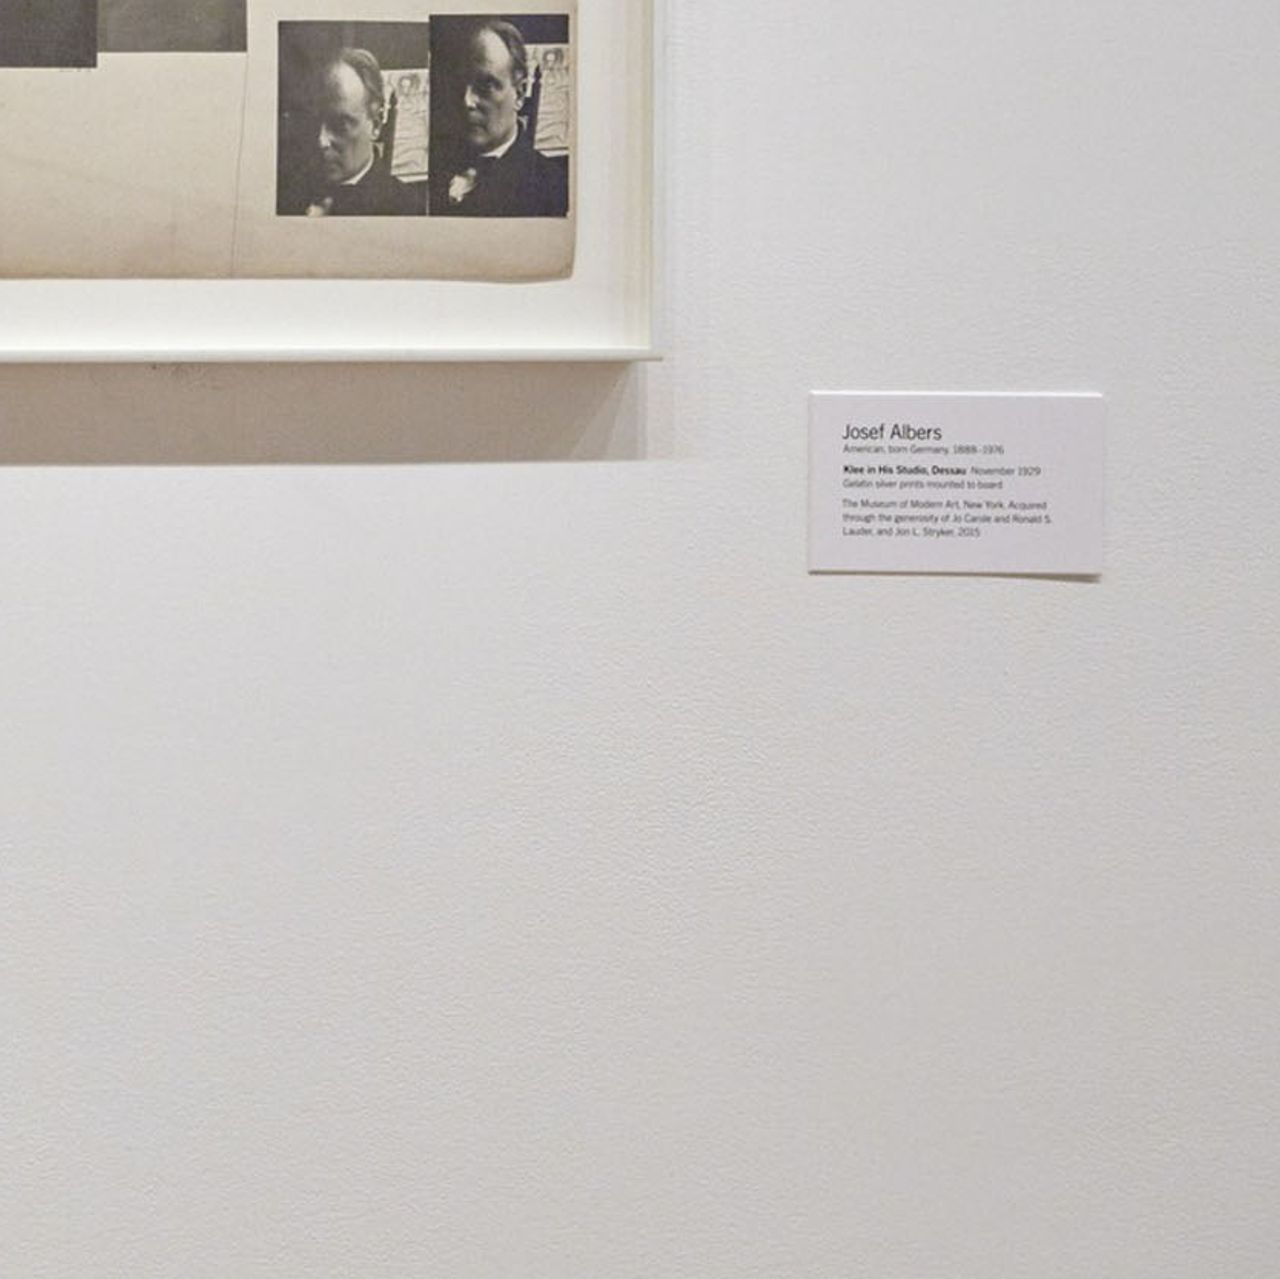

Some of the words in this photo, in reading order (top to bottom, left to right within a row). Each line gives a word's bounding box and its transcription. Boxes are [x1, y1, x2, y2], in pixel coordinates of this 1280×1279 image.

[842, 423, 884, 441] Josef
[889, 423, 943, 441] Albers
[888, 444, 907, 454] born
[843, 465, 865, 475] Klee
[867, 465, 876, 475] in
[878, 465, 894, 475] His
[896, 465, 929, 476] Studio,
[970, 465, 1015, 476] November
[842, 479, 873, 489] Gelatin
[875, 479, 897, 489] silver
[899, 479, 924, 490] prints
[926, 479, 965, 489] mounted
[967, 480, 976, 490] to
[977, 480, 1003, 490] board
[842, 499, 858, 508] The
[860, 499, 898, 509] Museum
[900, 499, 908, 509] of
[910, 499, 943, 509] Modern
[962, 500, 983, 510] New
[842, 513, 876, 524] through
[878, 513, 892, 523] the
[894, 513, 939, 524] generosity
[941, 513, 950, 523] of
[994, 513, 1010, 524] and
[876, 527, 893, 537] and
